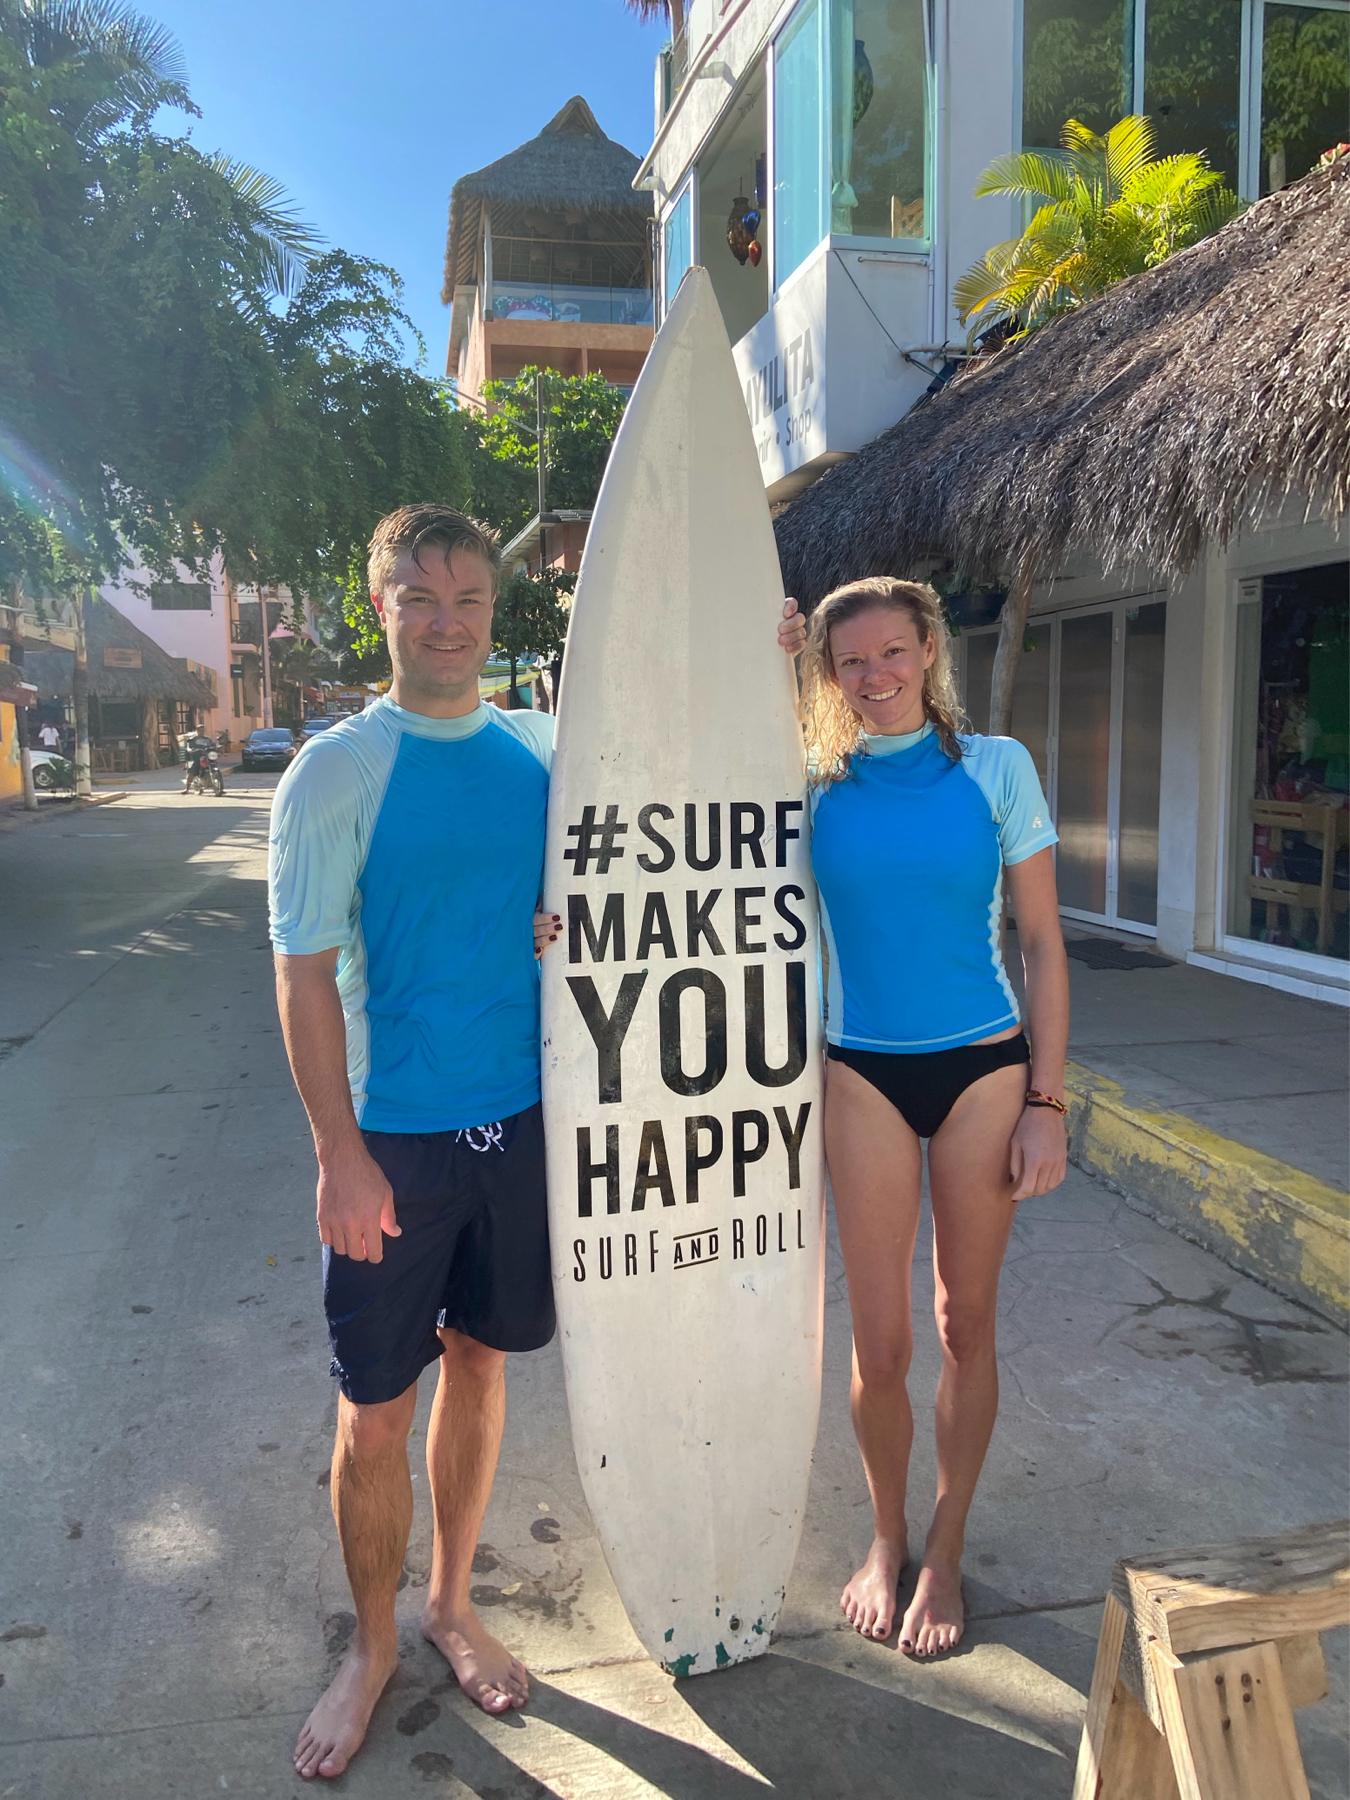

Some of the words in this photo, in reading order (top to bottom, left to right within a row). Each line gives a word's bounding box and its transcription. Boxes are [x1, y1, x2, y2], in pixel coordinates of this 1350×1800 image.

[563, 800, 804, 876] #SURF
[567, 884, 807, 964] MAKES
[565, 961, 808, 1105] YOU
[576, 1102, 812, 1218] HAPPY
[573, 1229, 660, 1283] SURF
[673, 1233, 719, 1264] AND
[732, 1209, 806, 1260] ROLL
